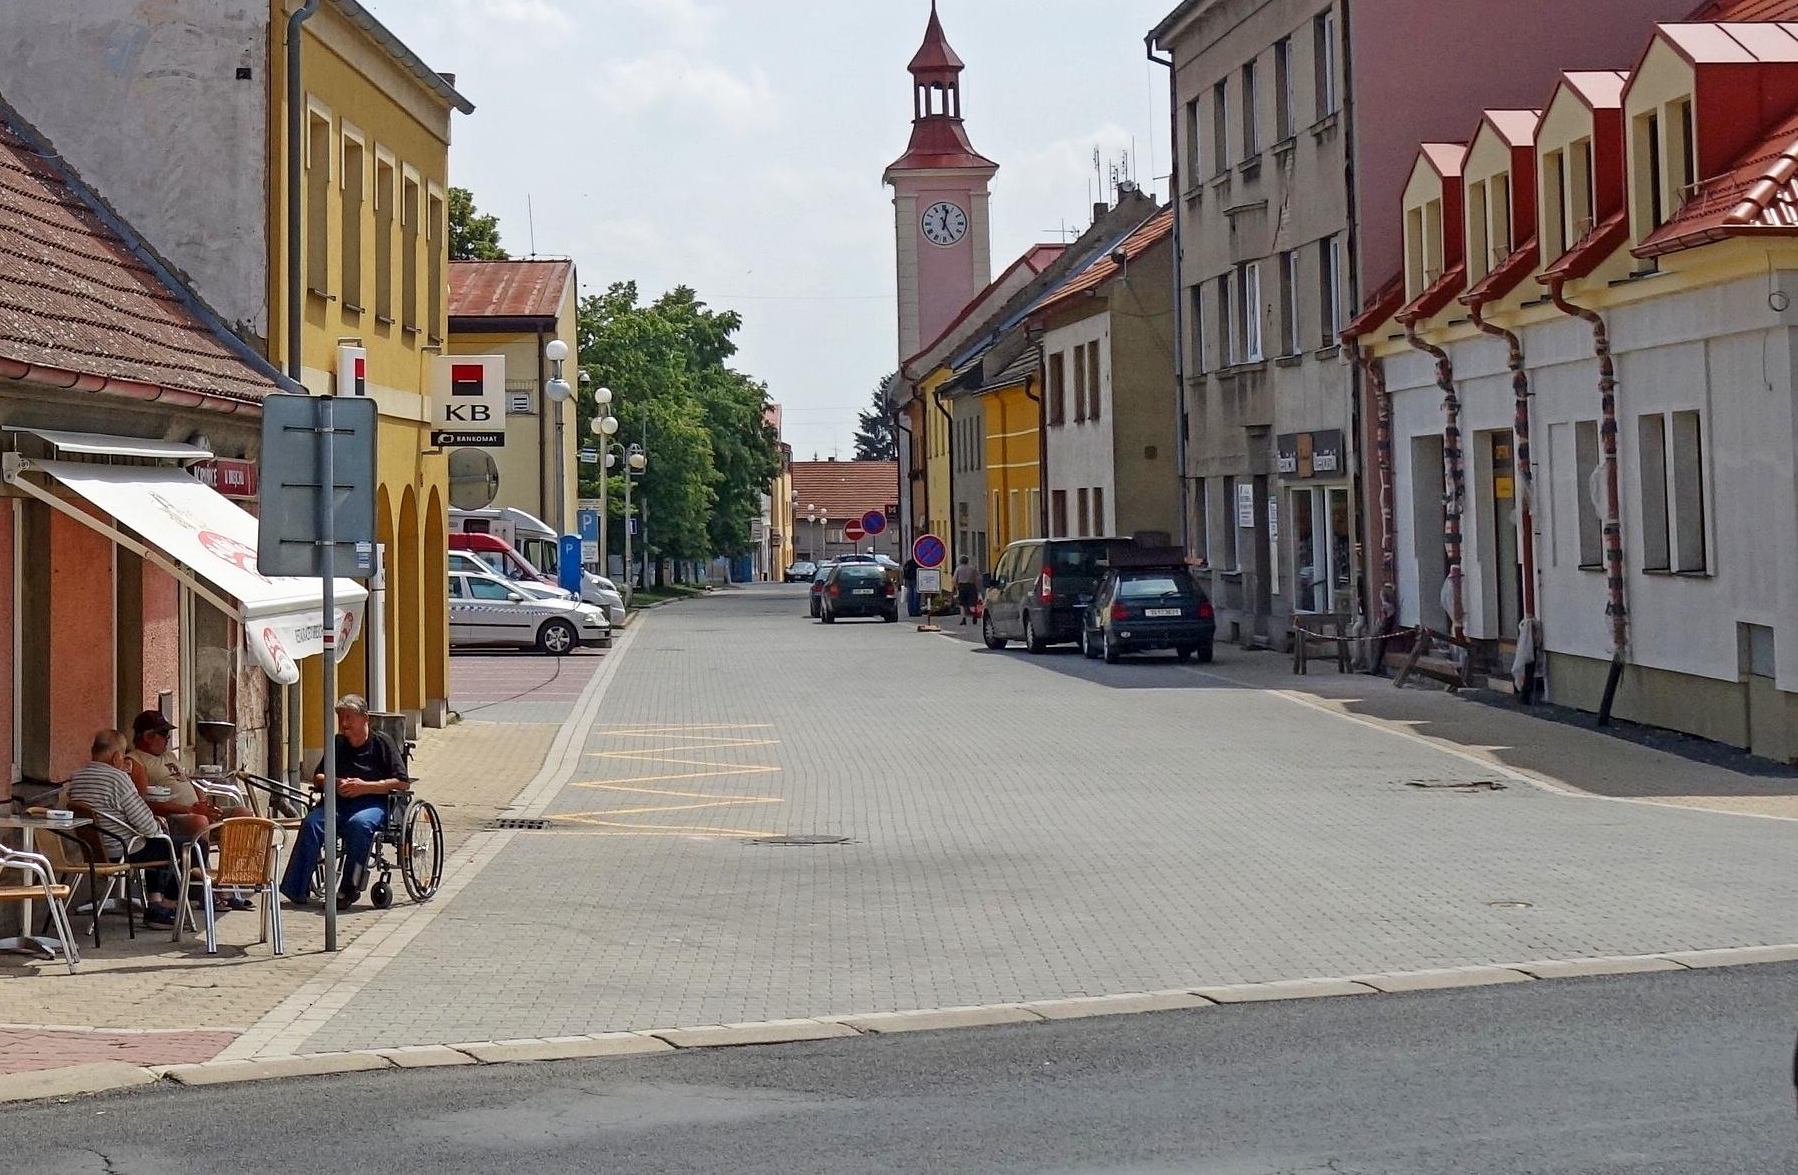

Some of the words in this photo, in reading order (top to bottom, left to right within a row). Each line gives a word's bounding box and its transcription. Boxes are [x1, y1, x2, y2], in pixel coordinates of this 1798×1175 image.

[445, 404, 491, 422] KB
[582, 514, 592, 531] P
[565, 543, 574, 554] P
